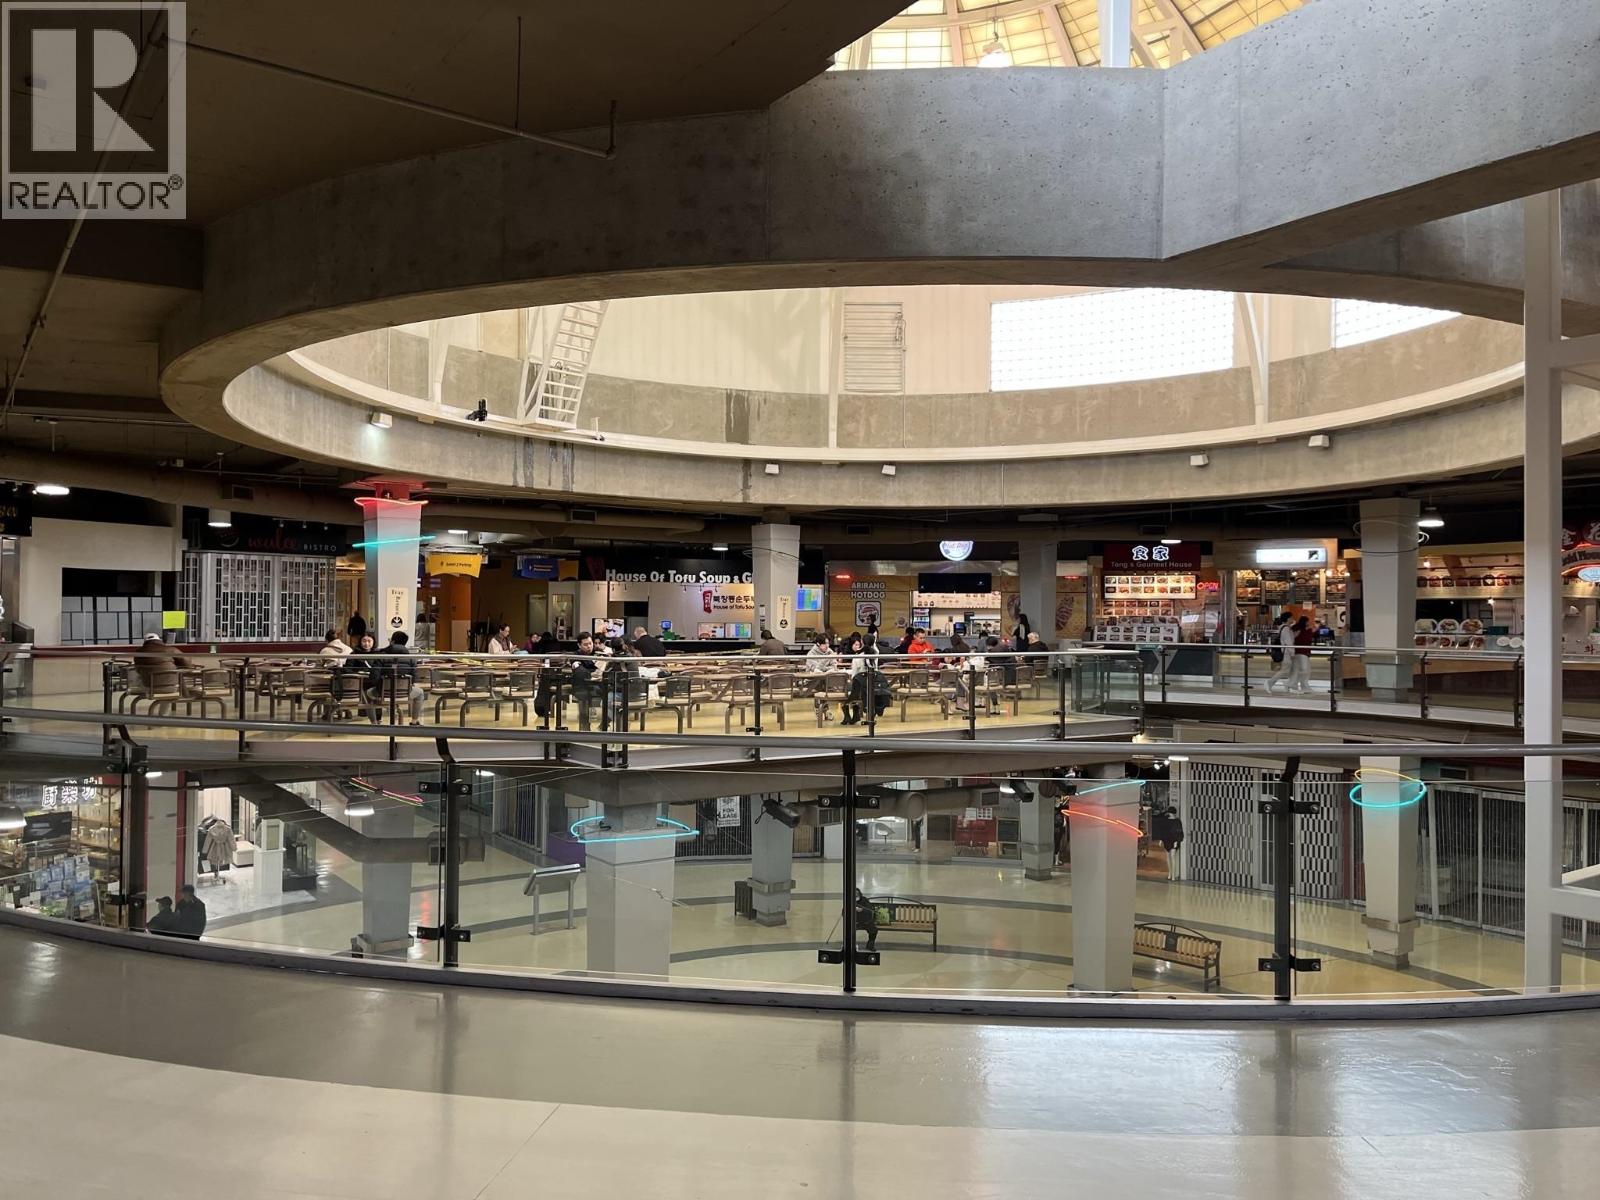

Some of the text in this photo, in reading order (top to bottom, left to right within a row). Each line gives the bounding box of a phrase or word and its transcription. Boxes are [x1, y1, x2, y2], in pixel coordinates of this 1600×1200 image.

[304, 543, 337, 552] BISTRO
[1132, 545, 1169, 561] 食家
[605, 568, 647, 582] House
[650, 570, 665, 582] Of
[667, 570, 696, 583] Tofu
[699, 570, 731, 584] Soup
[733, 576, 739, 584] &
[1196, 582, 1219, 591] OPEN
[850, 591, 886, 599] HOTDOG
